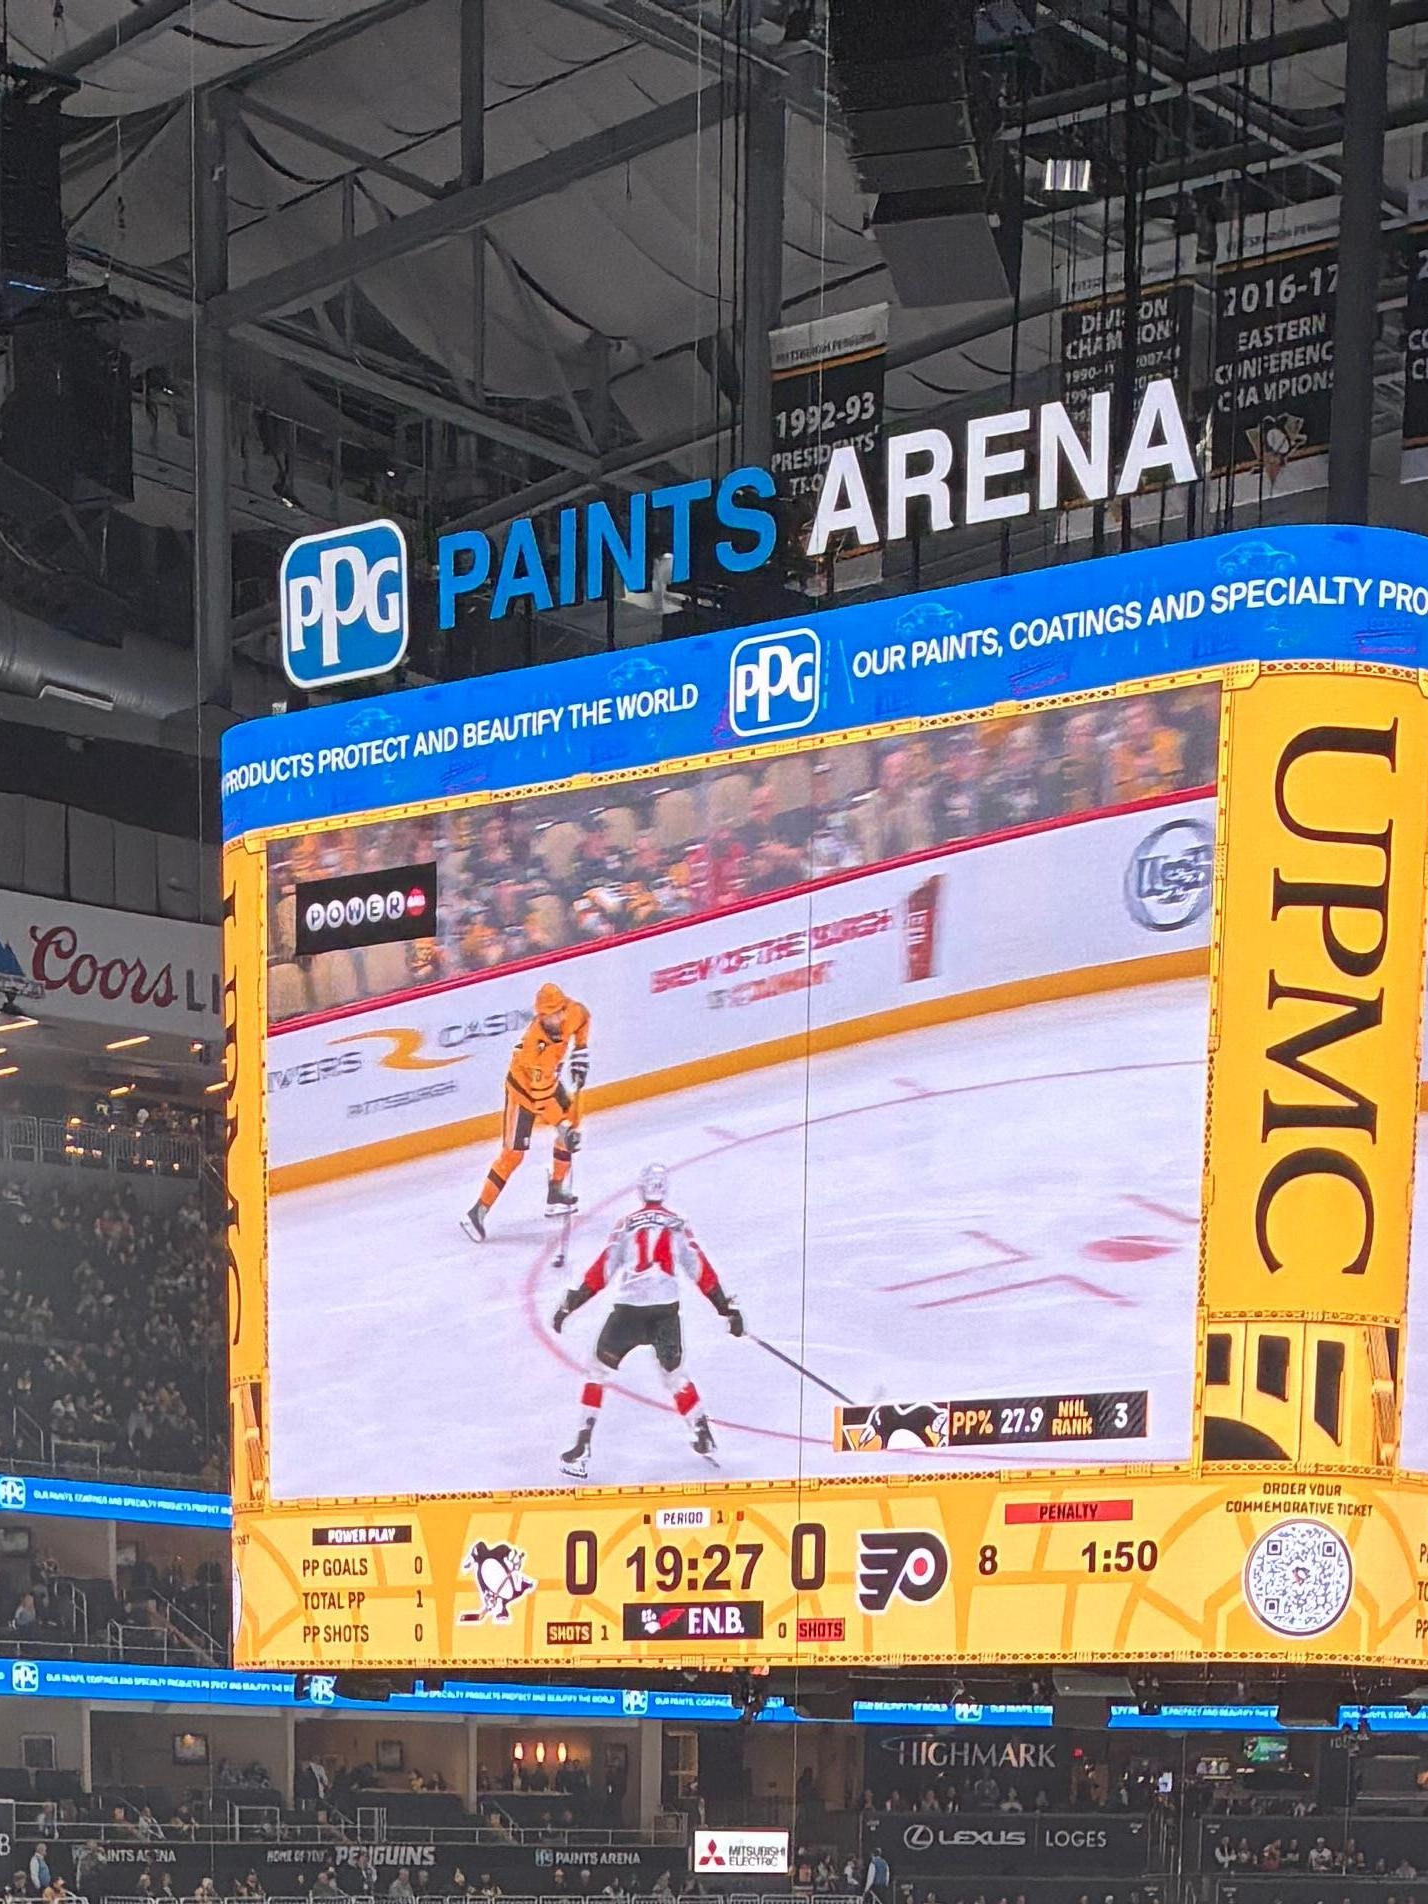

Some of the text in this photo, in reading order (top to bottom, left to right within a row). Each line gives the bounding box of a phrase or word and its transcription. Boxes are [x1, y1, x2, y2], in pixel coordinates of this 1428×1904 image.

[1223, 263, 1340, 318] 2016-17
[1239, 312, 1327, 352] EASTERN
[776, 391, 875, 439] 1992-93
[289, 546, 402, 666] PPG
[438, 467, 777, 630] PAINTS
[806, 379, 1199, 556] ARENA
[224, 755, 314, 797] PRODUCTS
[318, 736, 409, 774] PROTECT
[413, 728, 459, 757] AND
[463, 707, 565, 749] BEAUTIFY
[568, 700, 612, 728] THE
[616, 683, 698, 722] WORLD
[852, 650, 905, 679] OUR
[911, 628, 1003, 668] PAINTS,
[1009, 601, 1142, 650] COATINGS
[1147, 590, 1205, 626] AND
[1210, 576, 1373, 615] SPECIALTY
[307, 890, 405, 931] POWER
[30, 925, 177, 1007] Coors
[1255, 716, 1398, 1276] UPMC
[952, 1400, 1128, 1435] PP% 27.9 NHL 3
[1052, 1417, 1093, 1436] RANK
[1263, 1482, 1342, 1498] ORDER YOUR
[663, 1511, 703, 1526] PERIOD
[1039, 1503, 1099, 1521] PENALTY
[1226, 1500, 1373, 1517] COMMEMORATIVE TICKET
[328, 1527, 395, 1544] POWER PLAY
[302, 1557, 423, 1577] PP GOALS 0
[566, 1523, 825, 1595] 0 19:27 0
[979, 1539, 1158, 1575] 8 1:50
[303, 1590, 424, 1610] TOTAL PP 1
[303, 1624, 423, 1643] PP SHOTS 0
[548, 1625, 590, 1642] SHOTS
[798, 1620, 840, 1638] SHOTS
[899, 1741, 1056, 1767] HIGHMARK
[939, 1830, 1106, 1847] LEXUS LOGES
[729, 1845, 785, 1857] MITSUBISHI
